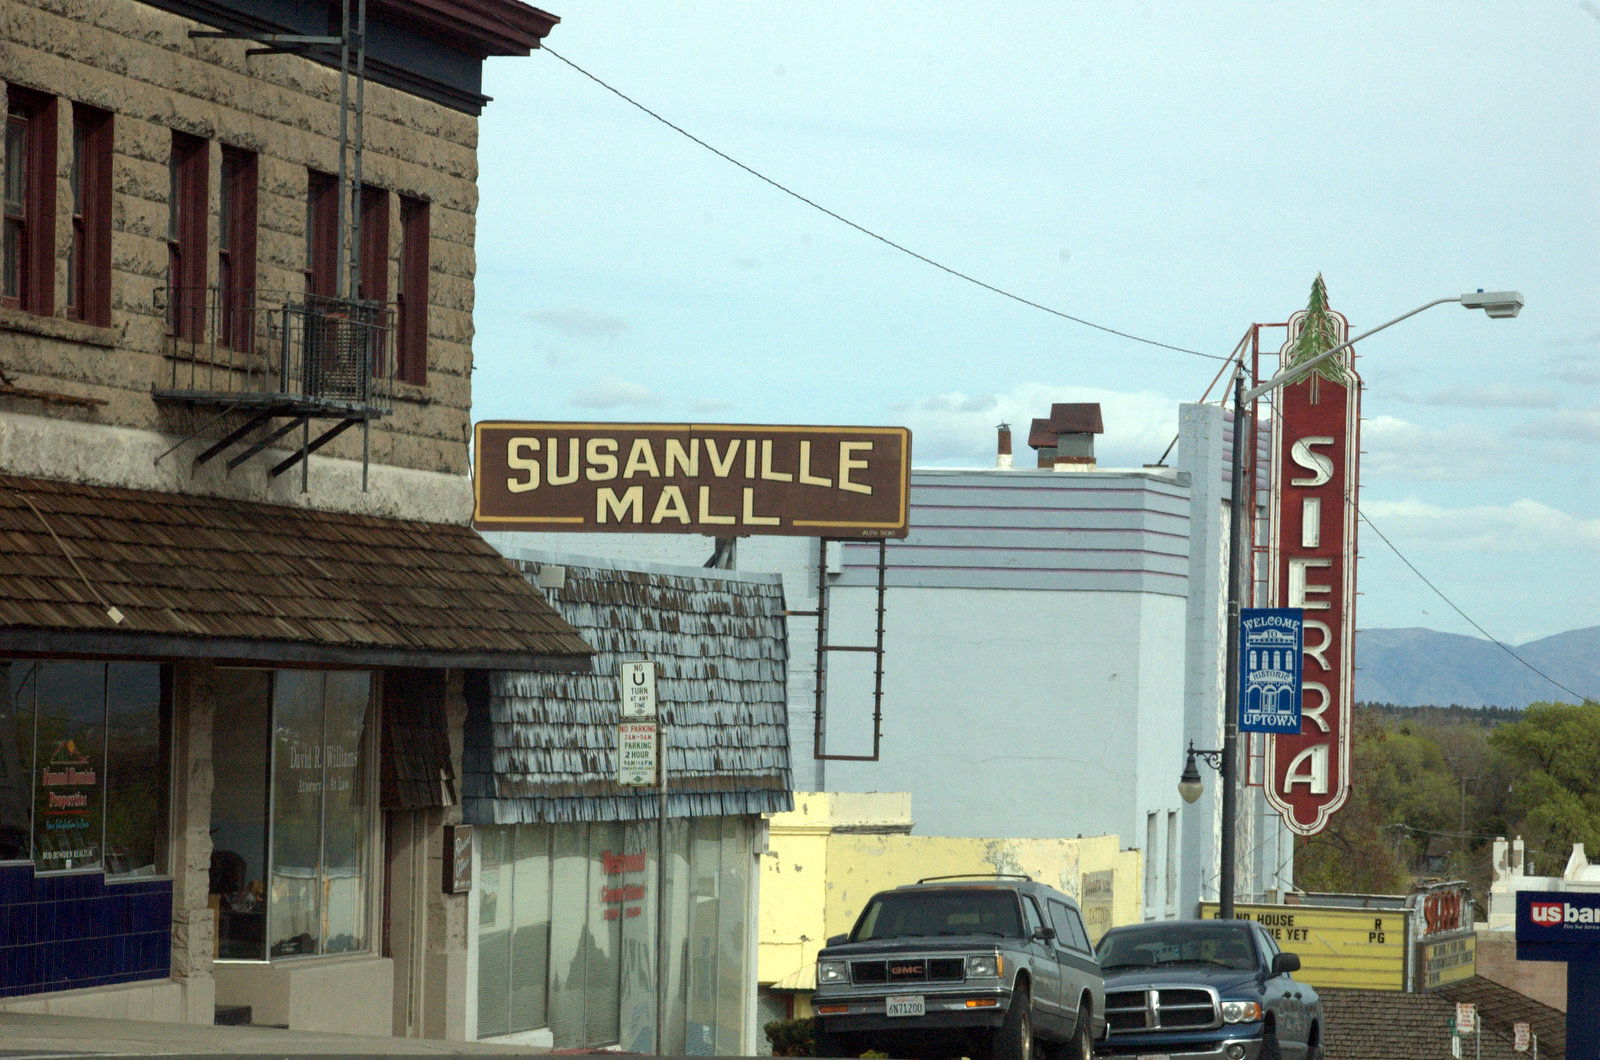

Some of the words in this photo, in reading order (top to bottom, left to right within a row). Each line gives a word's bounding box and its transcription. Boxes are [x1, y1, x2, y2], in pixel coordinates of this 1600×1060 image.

[506, 436, 874, 495] SUSANVILLE
[596, 485, 781, 526] MALL
[1284, 436, 1334, 794] SIERRA
[1242, 616, 1300, 630] WELCOME
[1266, 630, 1278, 638] TO
[633, 673, 645, 685] U
[1253, 670, 1290, 681] HISTORIC
[630, 687, 648, 695] TURN
[1243, 714, 1298, 727] UPTOWN
[630, 724, 656, 732] PARKING
[624, 741, 652, 750] PARKING
[289, 745, 312, 769] David
[326, 745, 358, 768] Williams
[624, 751, 630, 759] 2
[631, 751, 649, 759] HOUR
[1257, 914, 1294, 927] HOUSE
[1374, 918, 1382, 930] R
[1287, 929, 1309, 941] YET
[1368, 931, 1385, 944] PG
[891, 966, 923, 974] GMC
